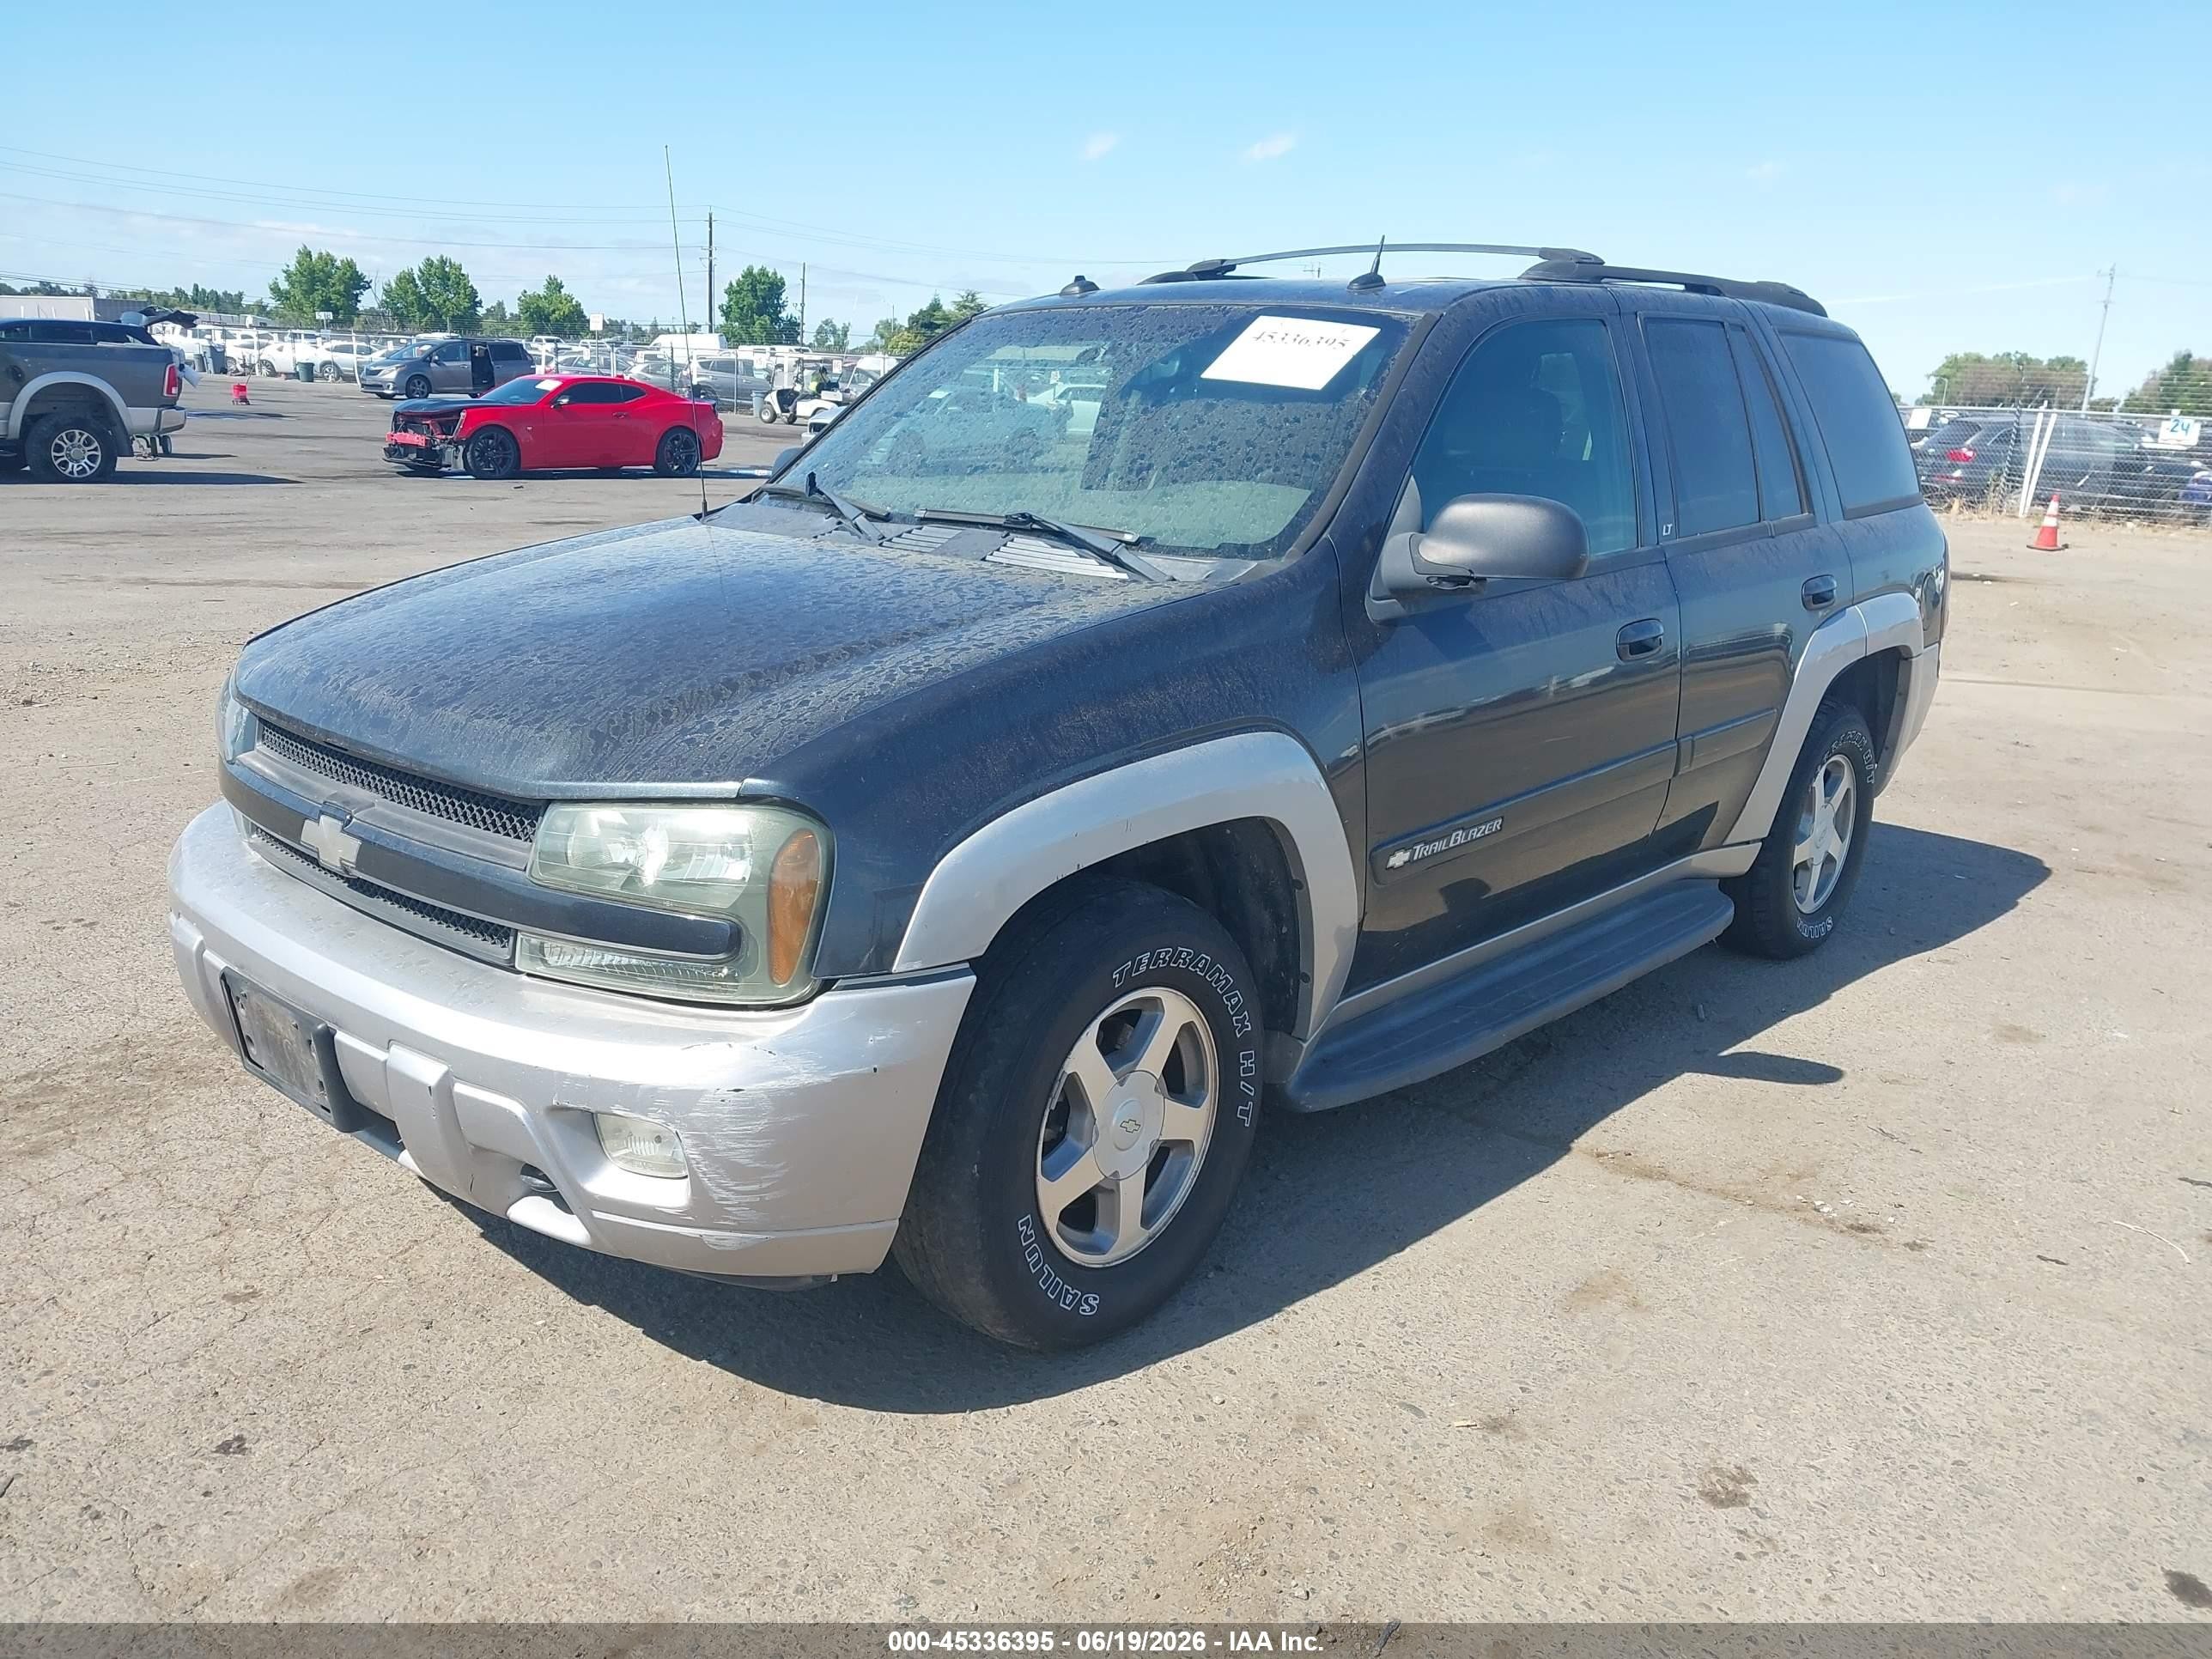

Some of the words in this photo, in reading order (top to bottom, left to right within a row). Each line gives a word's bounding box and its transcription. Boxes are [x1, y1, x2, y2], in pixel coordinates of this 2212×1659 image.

[2170, 418, 2191, 436] 24
[1662, 523, 1673, 537] LT
[1112, 946, 1253, 1039] TERRAMAX
[1236, 1050, 1257, 1127] H/T
[1018, 1214, 1100, 1316] SAILUN
